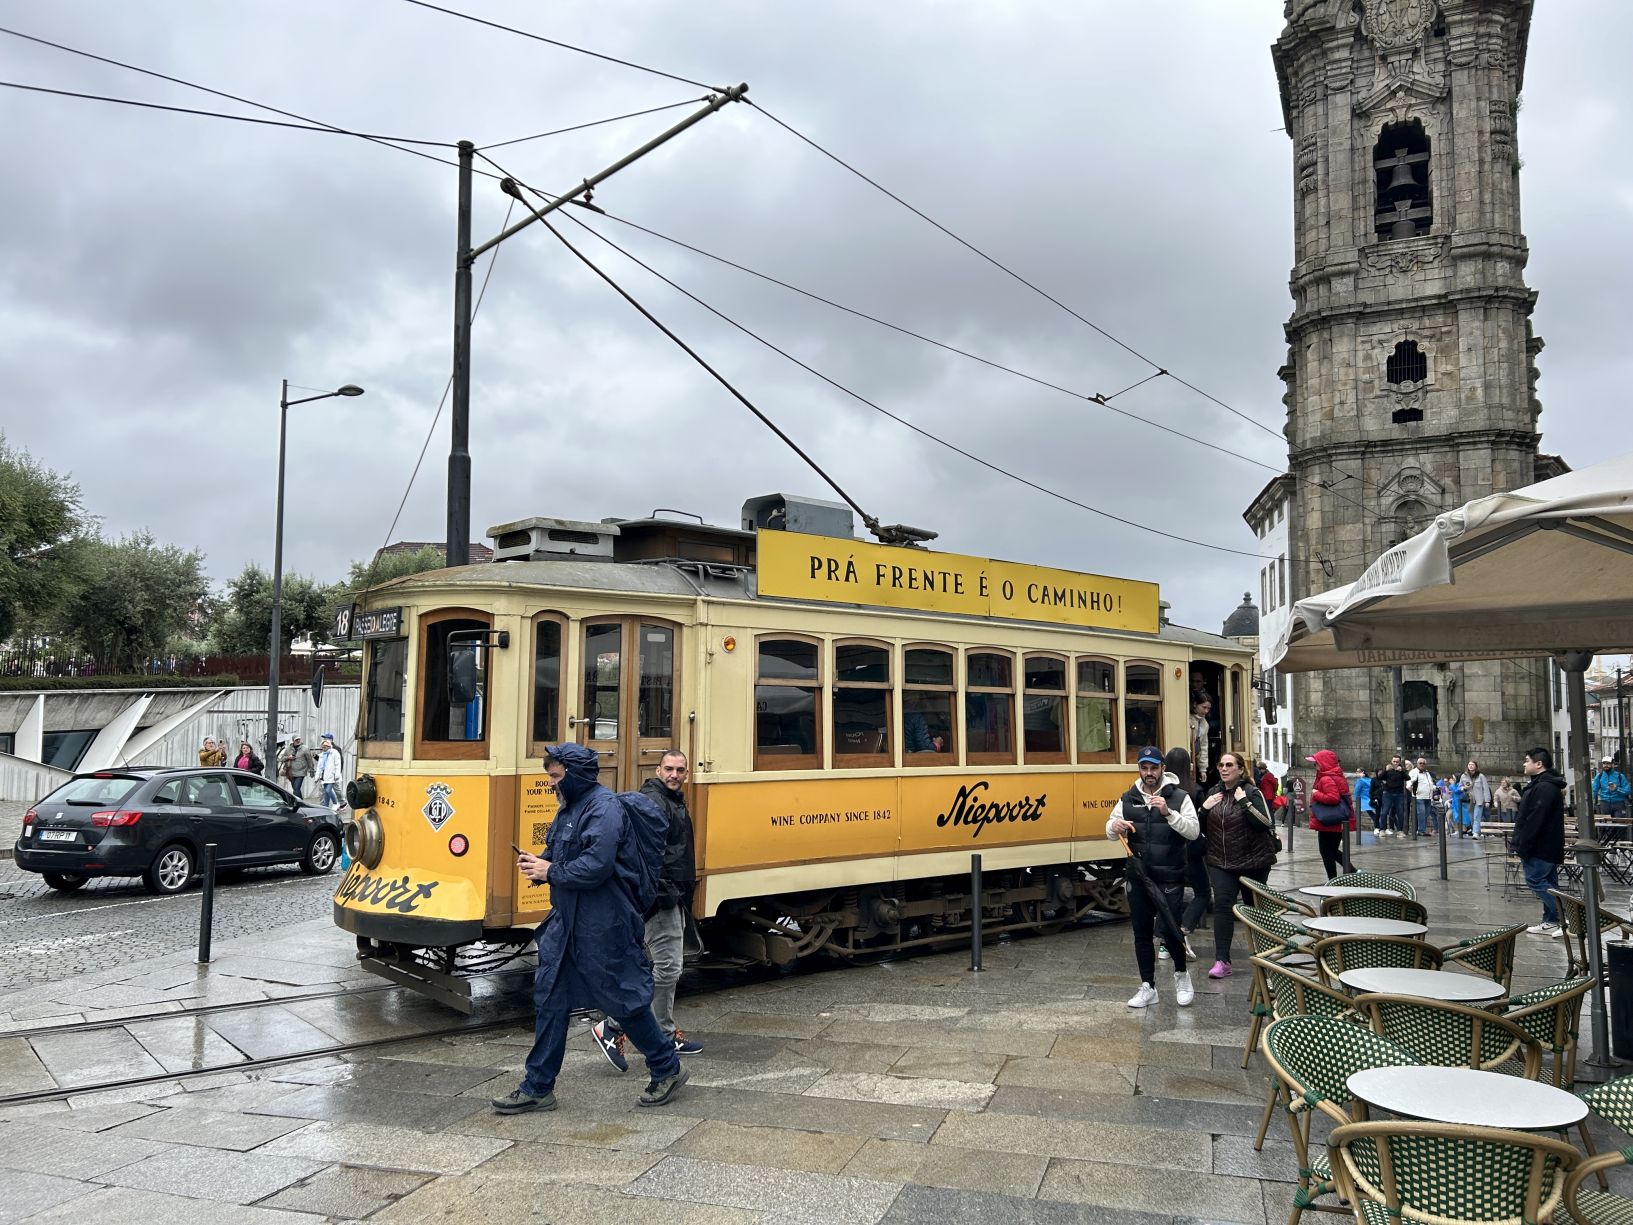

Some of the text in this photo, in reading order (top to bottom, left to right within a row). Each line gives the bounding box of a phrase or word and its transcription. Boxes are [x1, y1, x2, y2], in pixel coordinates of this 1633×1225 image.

[809, 554, 1121, 614] PRÁ FRENTE É O CAMINHO!
[336, 609, 349, 636] 18
[535, 780, 549, 788] BOO
[378, 796, 395, 808] 1842
[936, 781, 1047, 838] Niepoort
[1082, 800, 1098, 809] WINE
[770, 809, 891, 826] WINE COMPANY SINCE 1842
